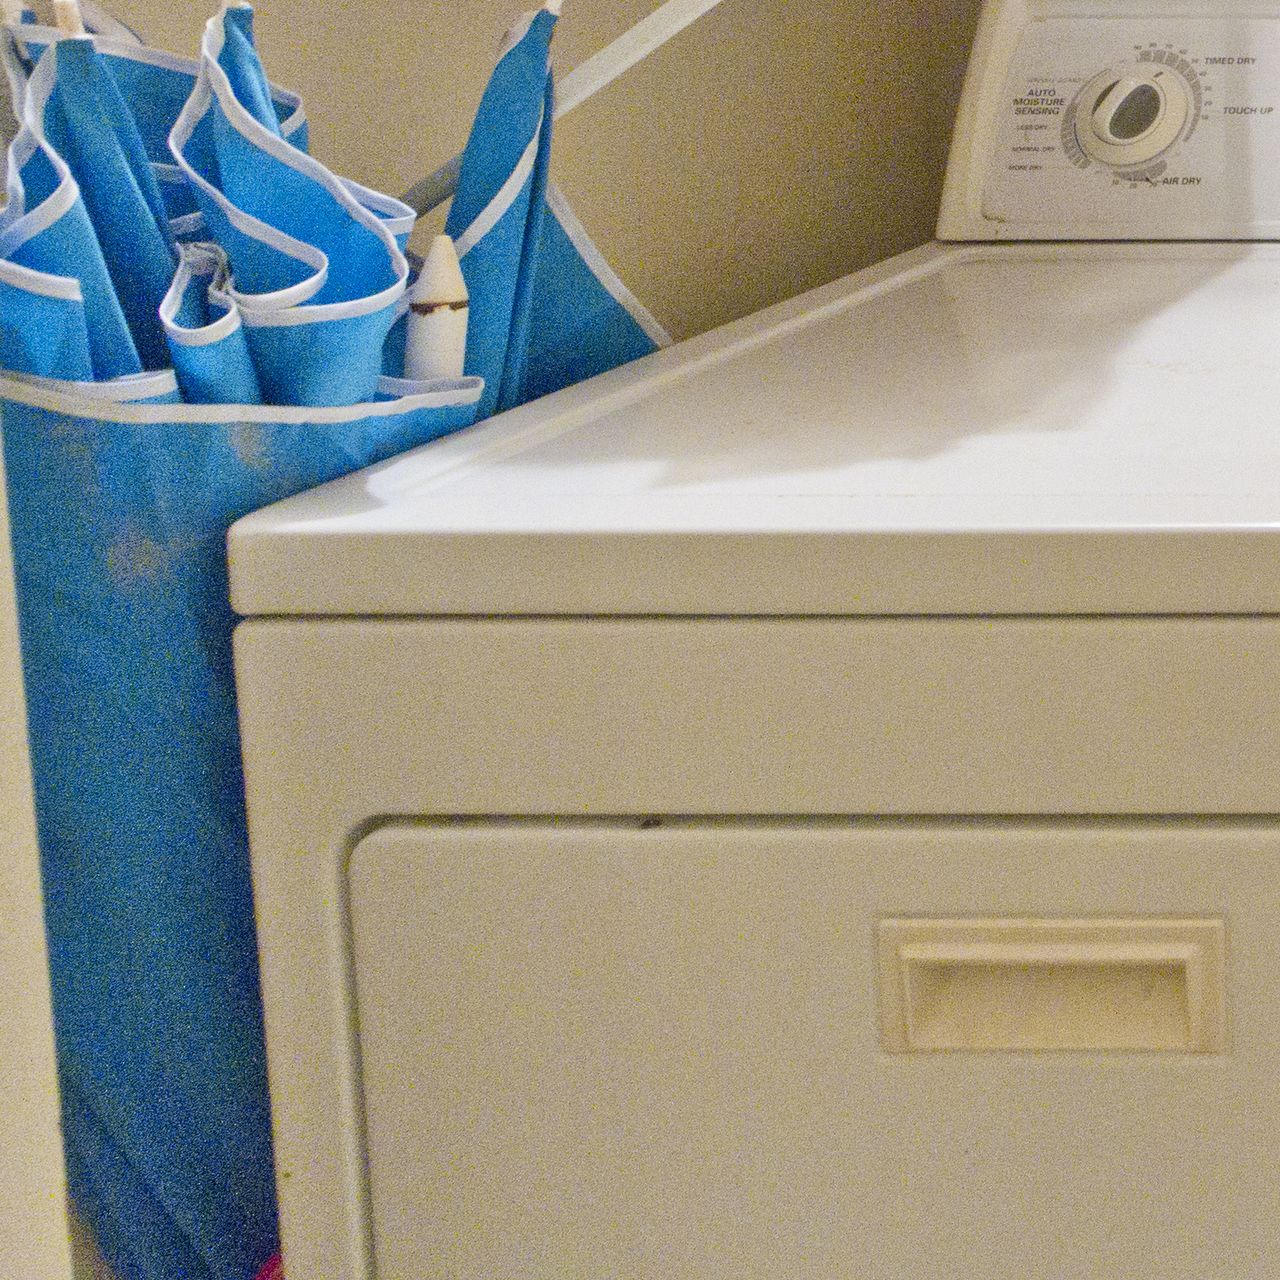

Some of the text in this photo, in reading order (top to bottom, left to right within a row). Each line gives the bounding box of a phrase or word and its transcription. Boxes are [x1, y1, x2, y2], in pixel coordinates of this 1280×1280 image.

[1204, 57, 1257, 65] TIMED DRY
[1027, 89, 1057, 97] AUTO
[1013, 98, 1065, 106] MOISTURE
[1014, 107, 1060, 115] SENSING
[1223, 107, 1274, 115] TOUCH UP
[1162, 177, 1179, 185] AIR
[1181, 177, 1202, 185] DRY
